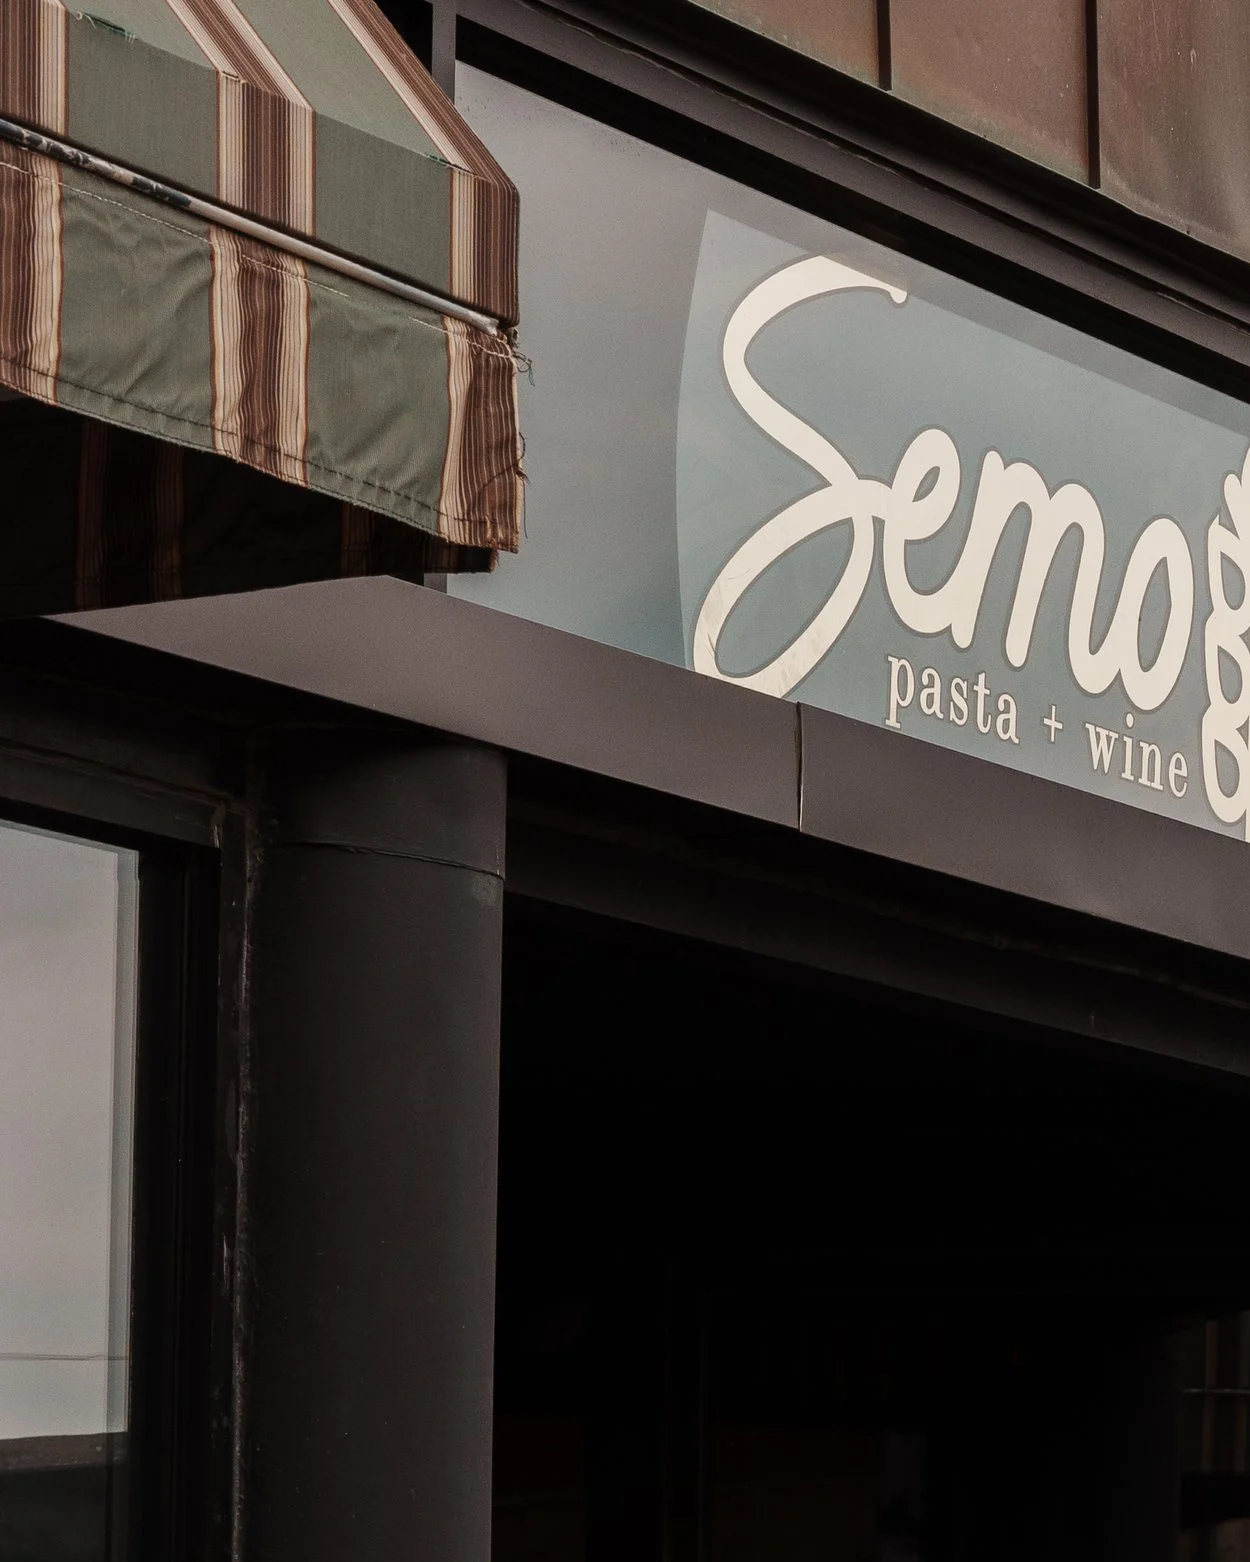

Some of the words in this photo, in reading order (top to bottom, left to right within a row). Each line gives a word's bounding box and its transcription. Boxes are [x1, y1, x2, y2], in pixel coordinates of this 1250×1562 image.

[694, 254, 1194, 711] Semo
[886, 655, 1020, 745] pasta
[1043, 705, 1064, 744] +
[1085, 713, 1189, 798] wine
